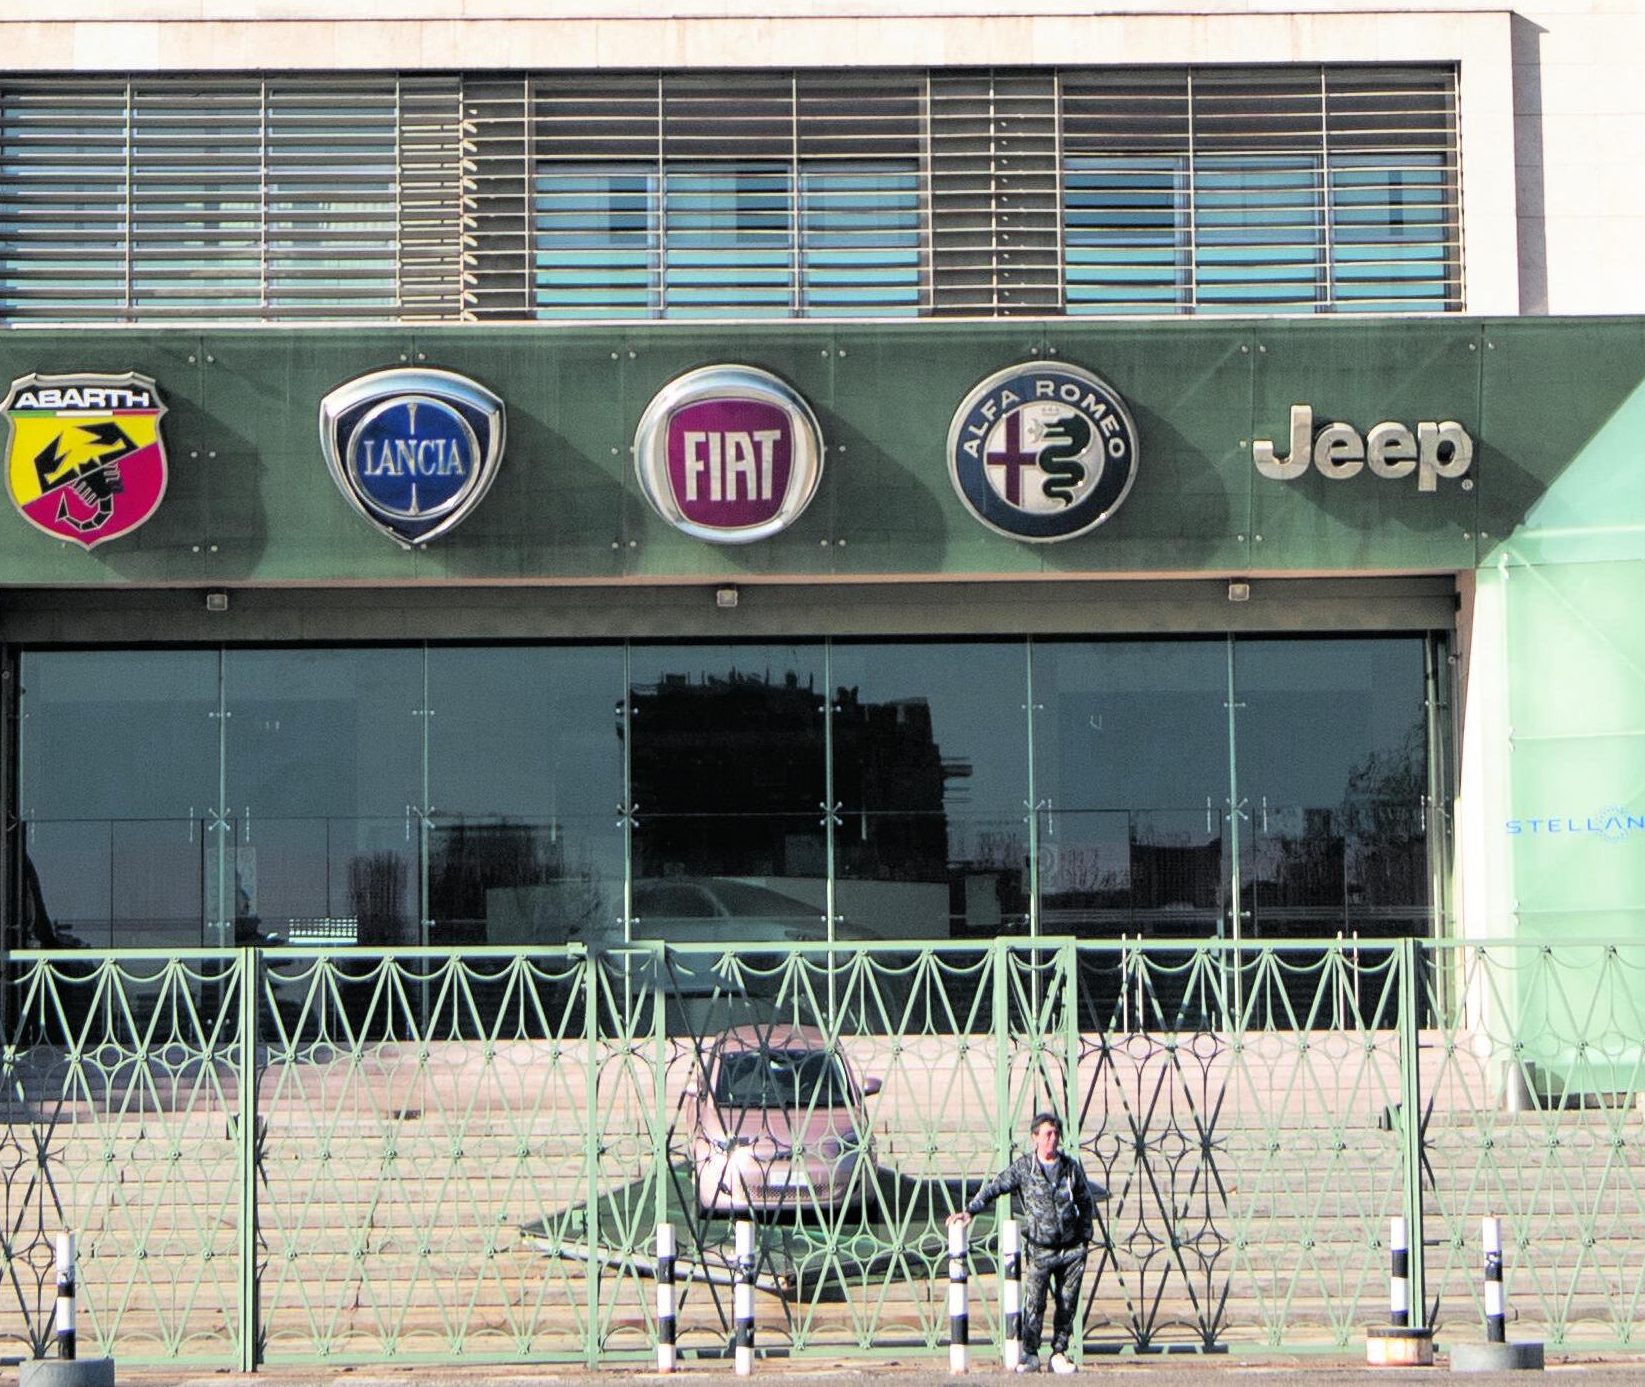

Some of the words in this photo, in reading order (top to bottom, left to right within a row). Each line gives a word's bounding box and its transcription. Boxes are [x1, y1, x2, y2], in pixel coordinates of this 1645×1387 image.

[14, 387, 150, 409] ABARTH
[962, 390, 1021, 458] ALFA
[1036, 380, 1126, 459] ROMEO
[363, 438, 466, 477] LANCIA
[683, 429, 782, 502] FIAT
[1252, 403, 1474, 492] Jeep
